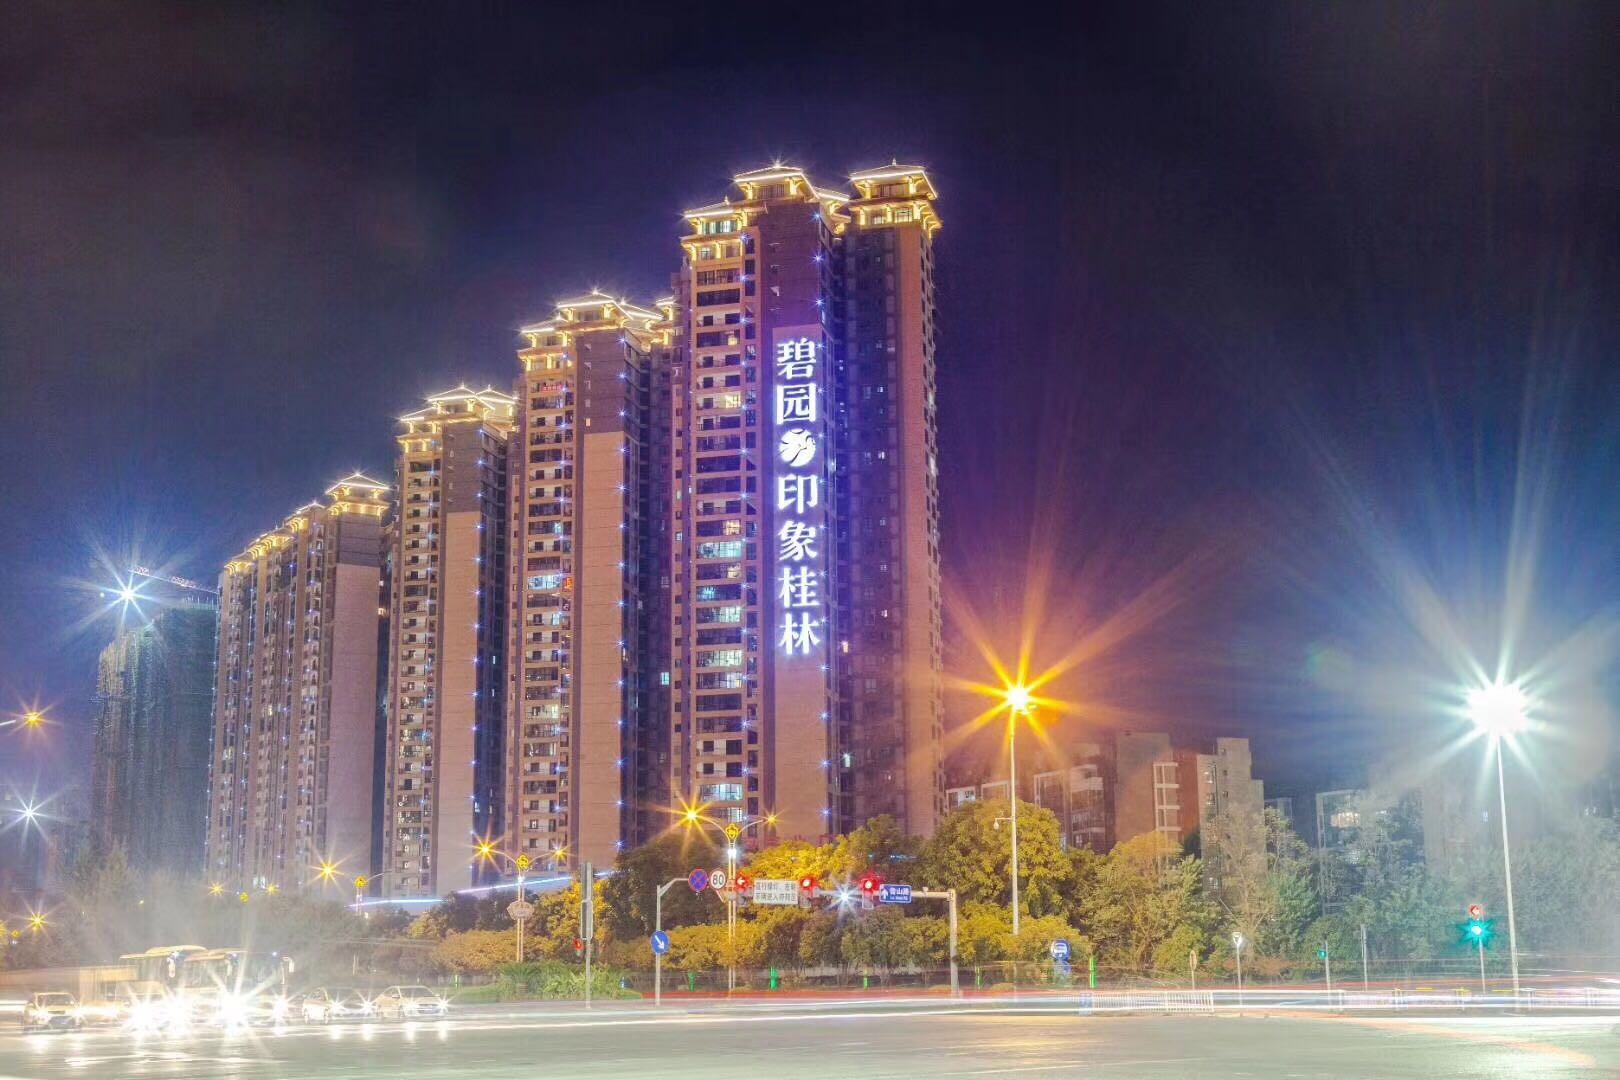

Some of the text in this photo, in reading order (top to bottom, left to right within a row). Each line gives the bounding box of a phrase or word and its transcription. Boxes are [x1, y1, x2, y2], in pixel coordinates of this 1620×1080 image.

[776, 338, 821, 655] 碧园 印象桂林
[712, 874, 725, 886] 80
